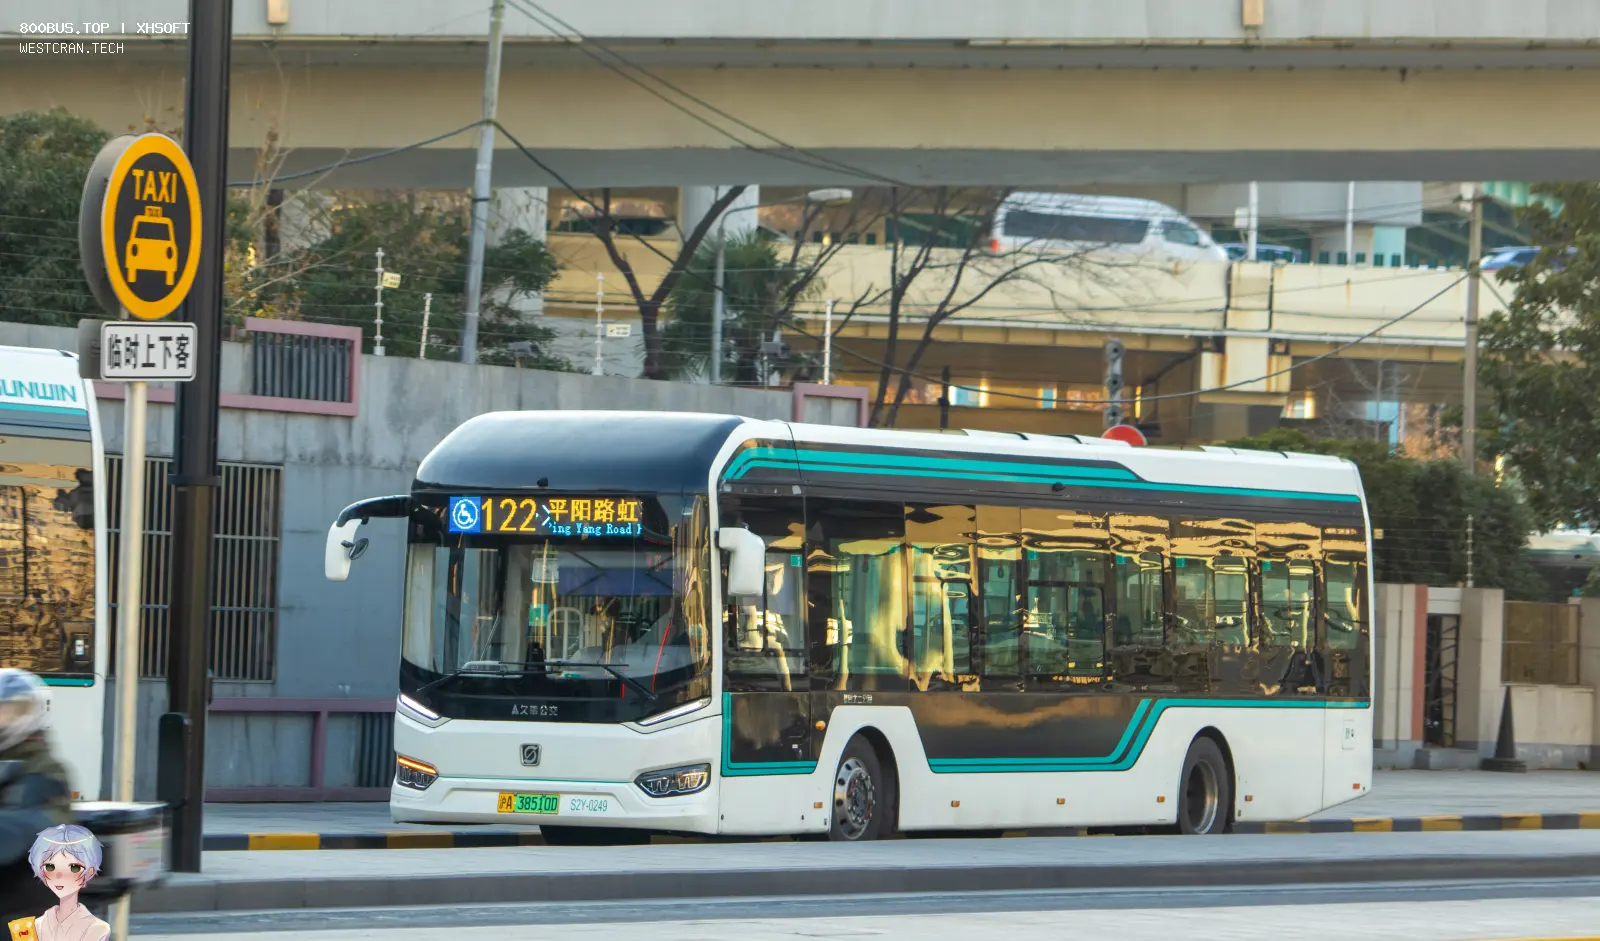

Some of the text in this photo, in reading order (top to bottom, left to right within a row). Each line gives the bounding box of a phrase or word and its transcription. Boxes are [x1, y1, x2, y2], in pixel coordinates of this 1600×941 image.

[132, 168, 177, 204] TAXI
[108, 333, 189, 370] 临时上下客
[0, 378, 77, 402] UNWIN
[481, 498, 537, 531] 122
[549, 499, 639, 522] 平阳路虹
[548, 522, 571, 536] ing
[576, 523, 602, 536] Yang
[606, 523, 633, 535] Road
[570, 798, 608, 812] S2Y-0249
